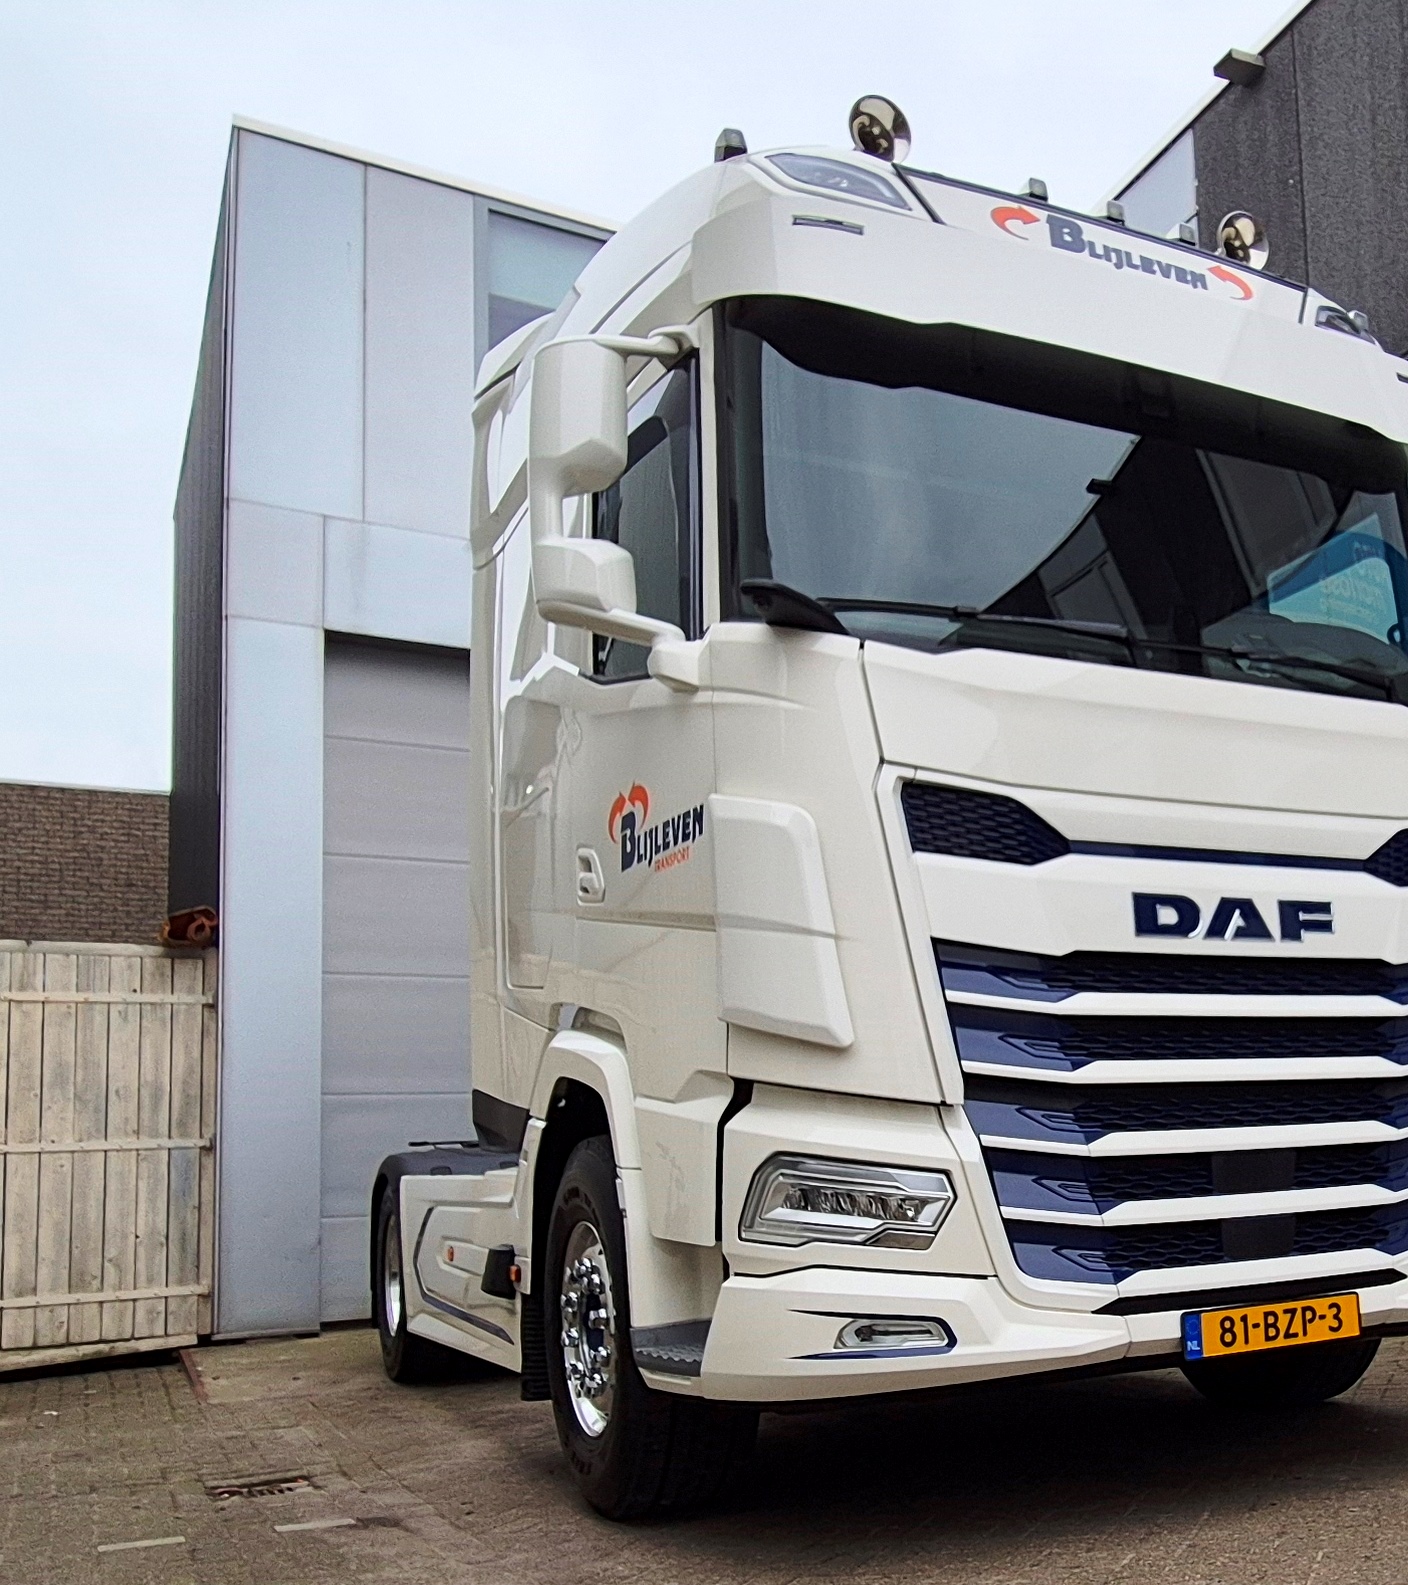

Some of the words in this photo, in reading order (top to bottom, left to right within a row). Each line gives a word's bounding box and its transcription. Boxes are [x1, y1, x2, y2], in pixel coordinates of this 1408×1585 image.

[655, 846, 690, 871] TRANSPORT
[1132, 892, 1334, 942] DAF
[1187, 1340, 1200, 1350] NL
[1219, 1302, 1343, 1348] 81-BZP-3
